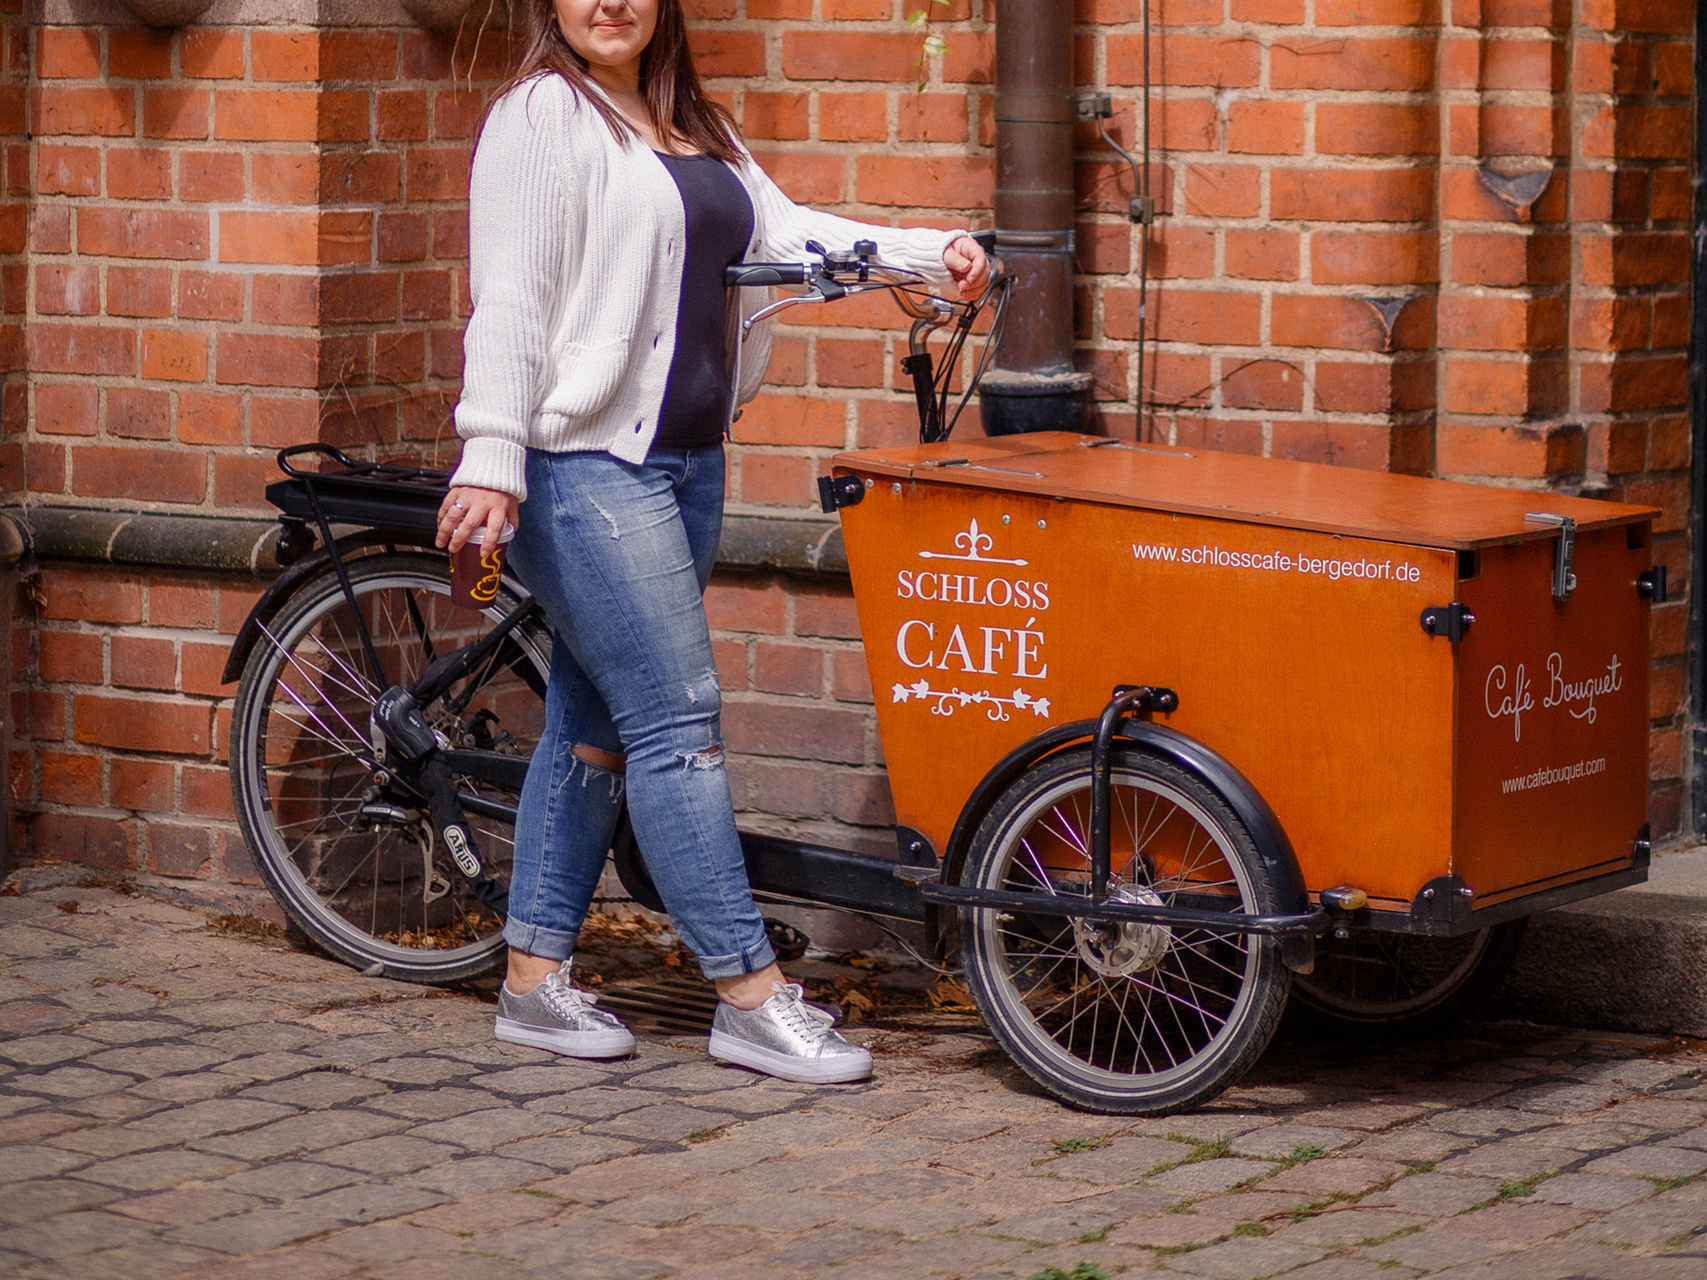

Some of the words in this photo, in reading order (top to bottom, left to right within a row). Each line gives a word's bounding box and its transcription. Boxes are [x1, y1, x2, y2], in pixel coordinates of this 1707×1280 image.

[1132, 543, 1421, 583] www.schlosscafe-bergedorf.de
[897, 569, 1050, 611] SCHLOSS
[896, 616, 1048, 680] CAFÉ
[1485, 663, 1535, 743] Café
[1543, 652, 1622, 724] Bouquet
[1501, 757, 1606, 795] www.cafebouquet.com
